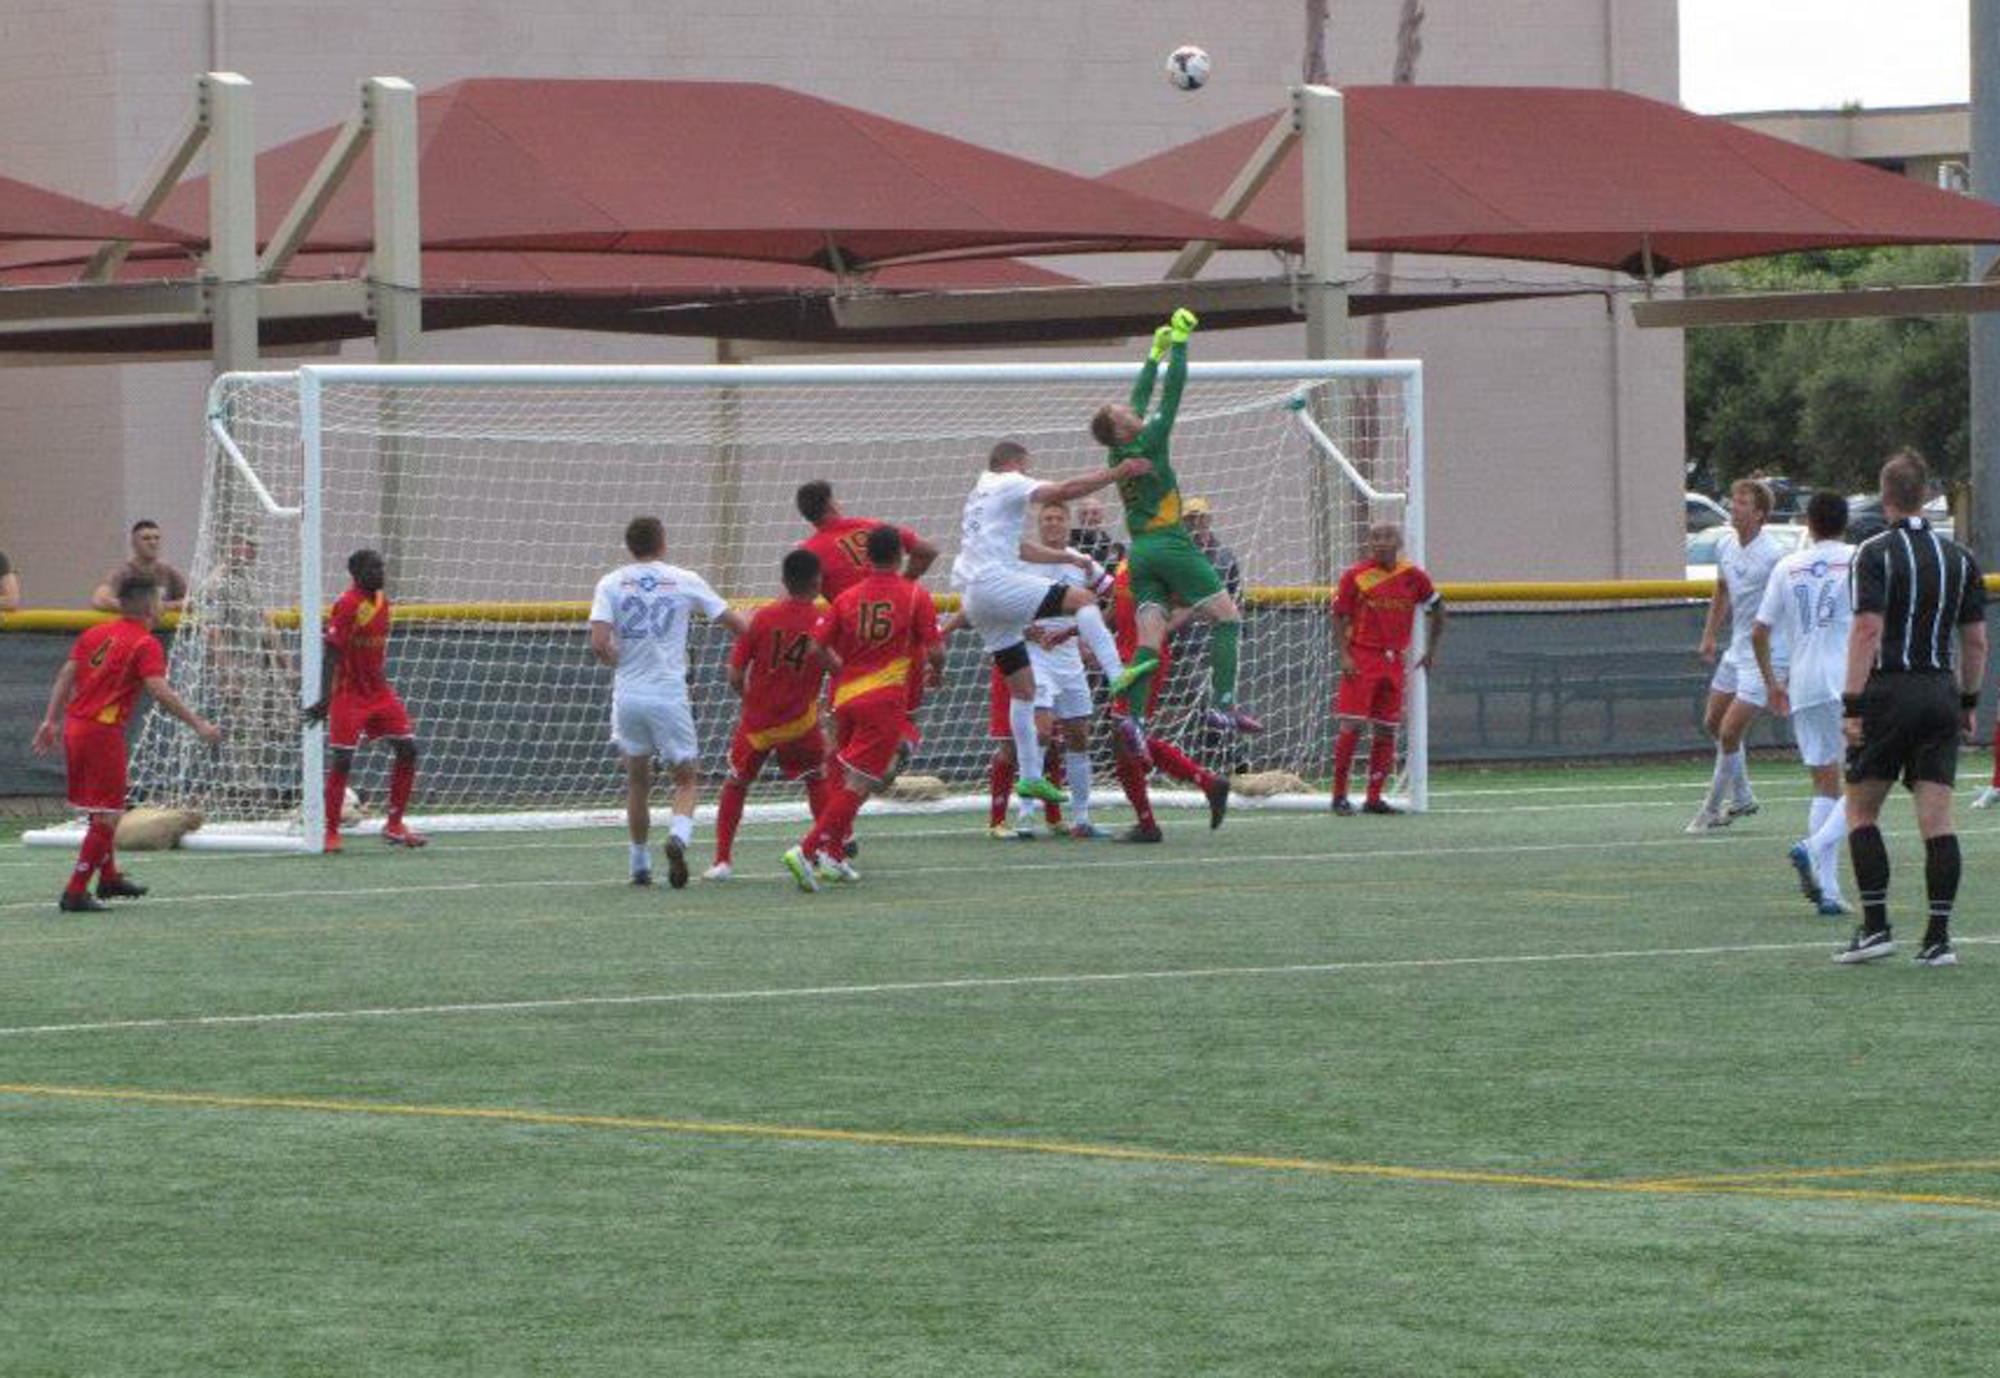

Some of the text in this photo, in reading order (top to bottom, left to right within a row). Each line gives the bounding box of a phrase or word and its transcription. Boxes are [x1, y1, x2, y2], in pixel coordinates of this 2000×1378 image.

[620, 596, 677, 639] 20
[859, 600, 892, 642] 16
[772, 628, 810, 671] 14
